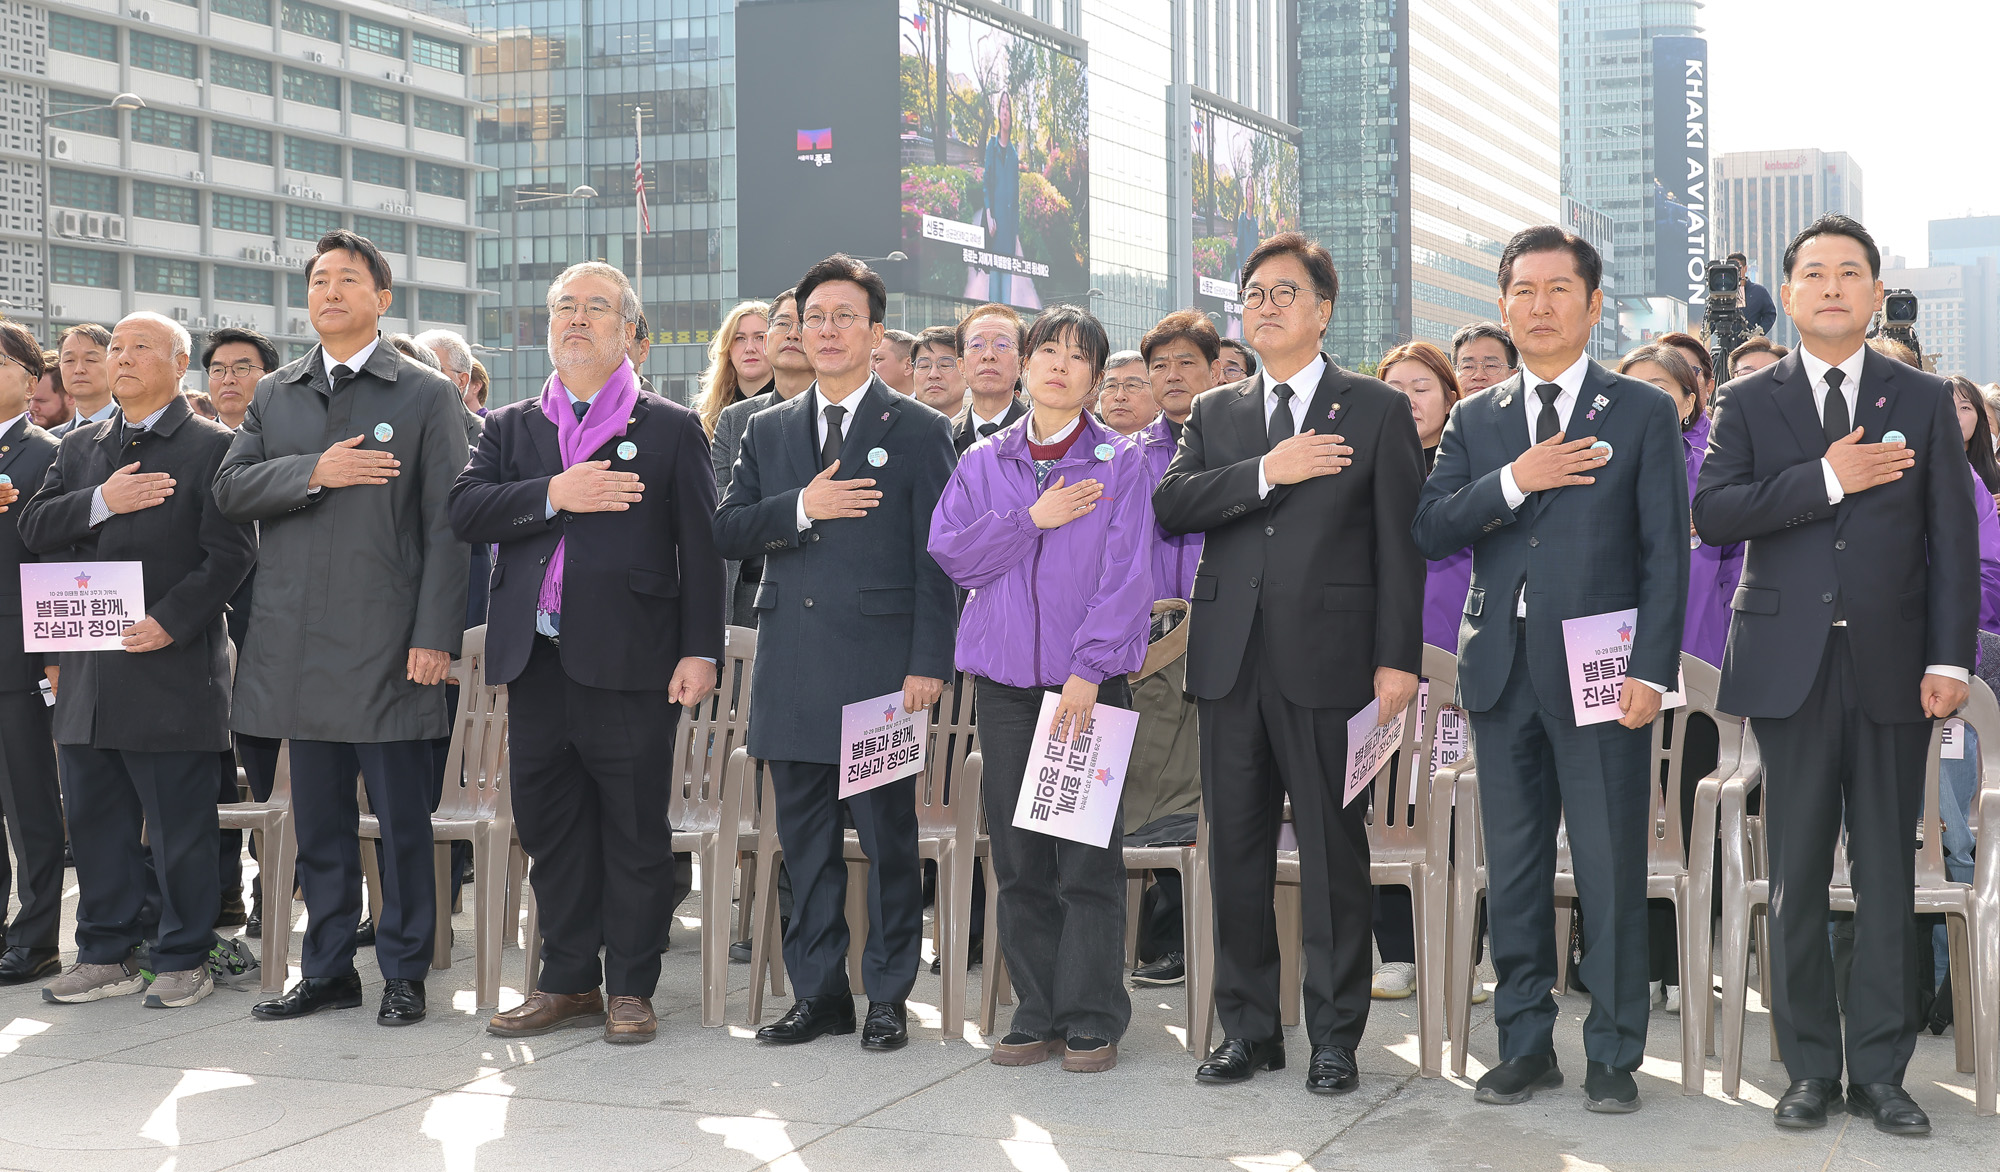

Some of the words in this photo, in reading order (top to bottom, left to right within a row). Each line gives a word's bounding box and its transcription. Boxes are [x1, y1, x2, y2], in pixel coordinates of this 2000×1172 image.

[1686, 59, 1703, 149] KHAKI
[814, 153, 832, 167] 종로
[1765, 160, 1800, 170] kobaco
[1687, 157, 1705, 305] AVIATION
[962, 248, 978, 264] 종로는
[36, 599, 86, 618] 별들과
[90, 598, 128, 618] 함께,
[33, 620, 84, 639] 진실과
[1582, 655, 1628, 683] 별들과
[852, 733, 889, 761] 별들과
[892, 724, 916, 749] 함께,
[1442, 704, 1459, 746] 들과
[847, 756, 885, 783] 진실과
[887, 743, 920, 770] 정의로
[1350, 750, 1376, 789] 진실과
[1378, 722, 1401, 760] 정의로
[1355, 728, 1381, 767] 별들과
[1030, 766, 1060, 821] 정의로
[1052, 775, 1081, 816] 함께,
